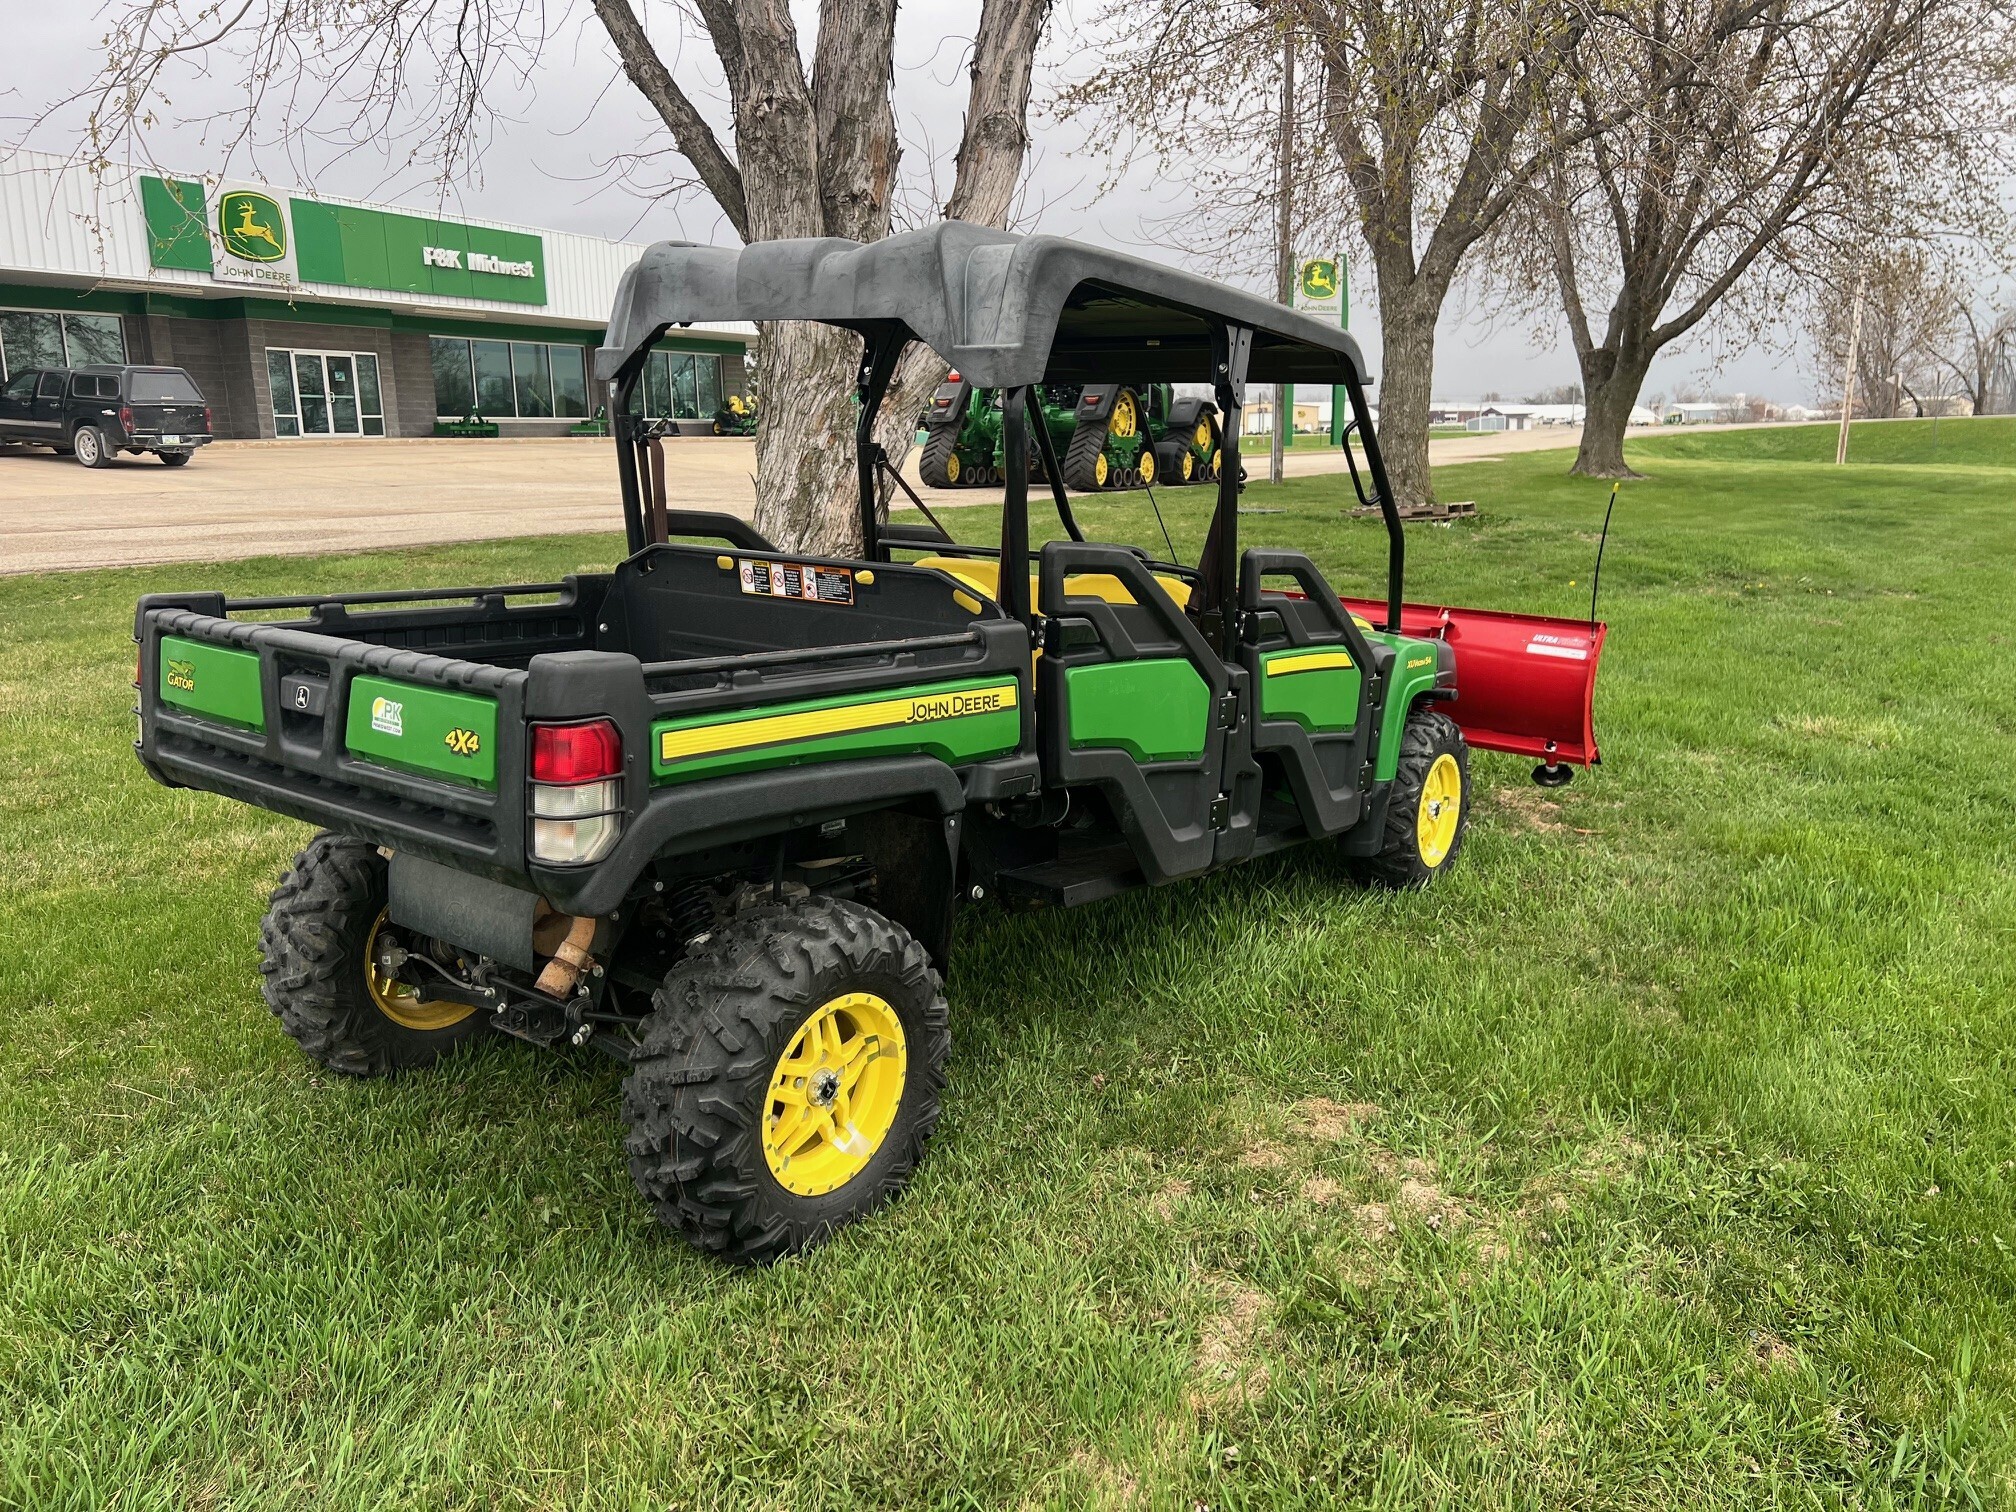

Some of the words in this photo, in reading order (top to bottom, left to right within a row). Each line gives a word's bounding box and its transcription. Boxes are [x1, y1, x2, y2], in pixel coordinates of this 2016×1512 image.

[423, 246, 463, 269] P&K
[467, 252, 535, 278] Midwest
[223, 266, 254, 277] JOHN
[256, 268, 291, 281] DEERE
[1318, 304, 1338, 312] DEERE
[1533, 634, 1559, 644] ULTRA
[167, 672, 194, 691] GATOR
[907, 701, 949, 721] JOHN
[953, 694, 1001, 713] DEERE
